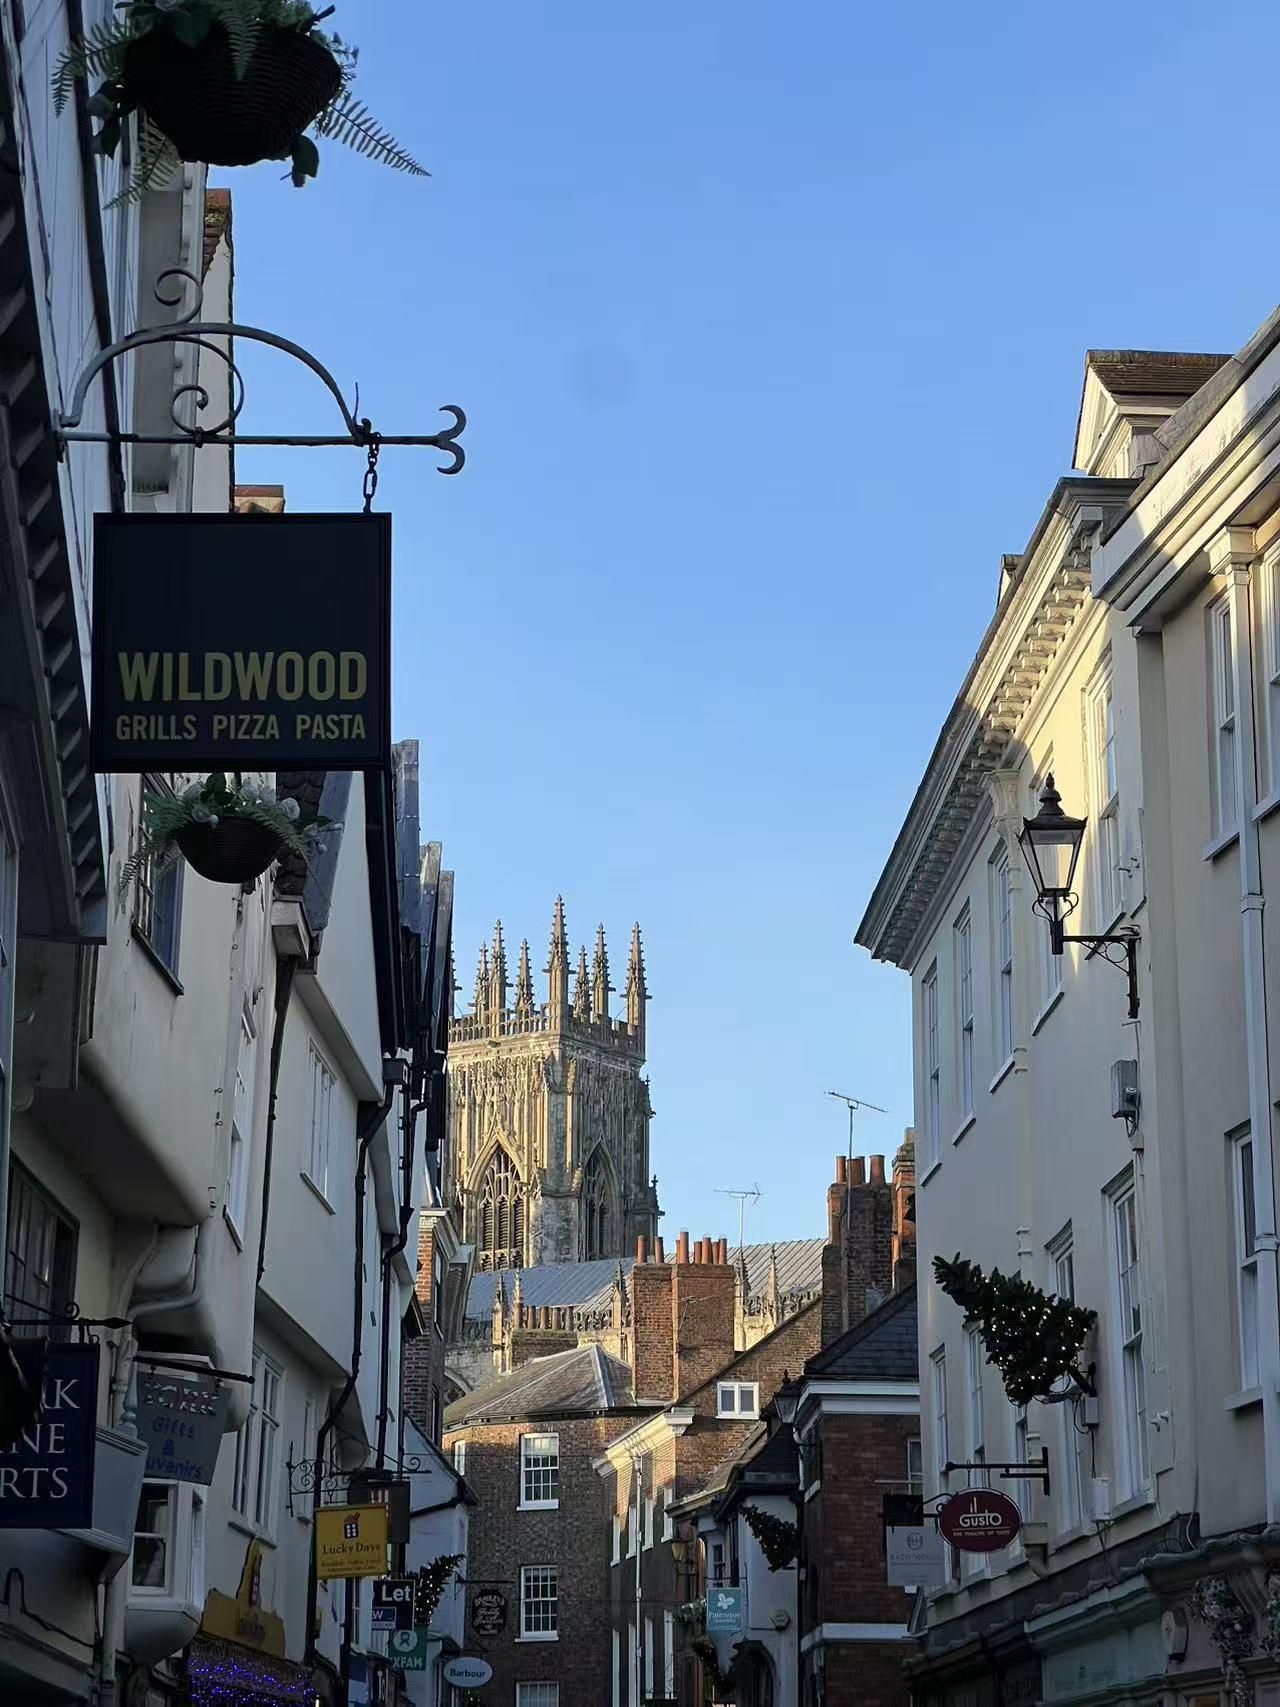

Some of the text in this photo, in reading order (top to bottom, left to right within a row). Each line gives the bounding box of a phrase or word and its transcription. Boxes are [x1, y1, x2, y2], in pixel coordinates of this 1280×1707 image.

[117, 650, 367, 702] WILDWOOD
[115, 713, 366, 741] GRILLS PIZZA PASTA
[152, 1414, 195, 1438] Gifts
[146, 1456, 202, 1480] uvenirs
[322, 1541, 381, 1556] Lucky Days
[381, 1584, 411, 1601] Let
[449, 1666, 486, 1679] Barbour
